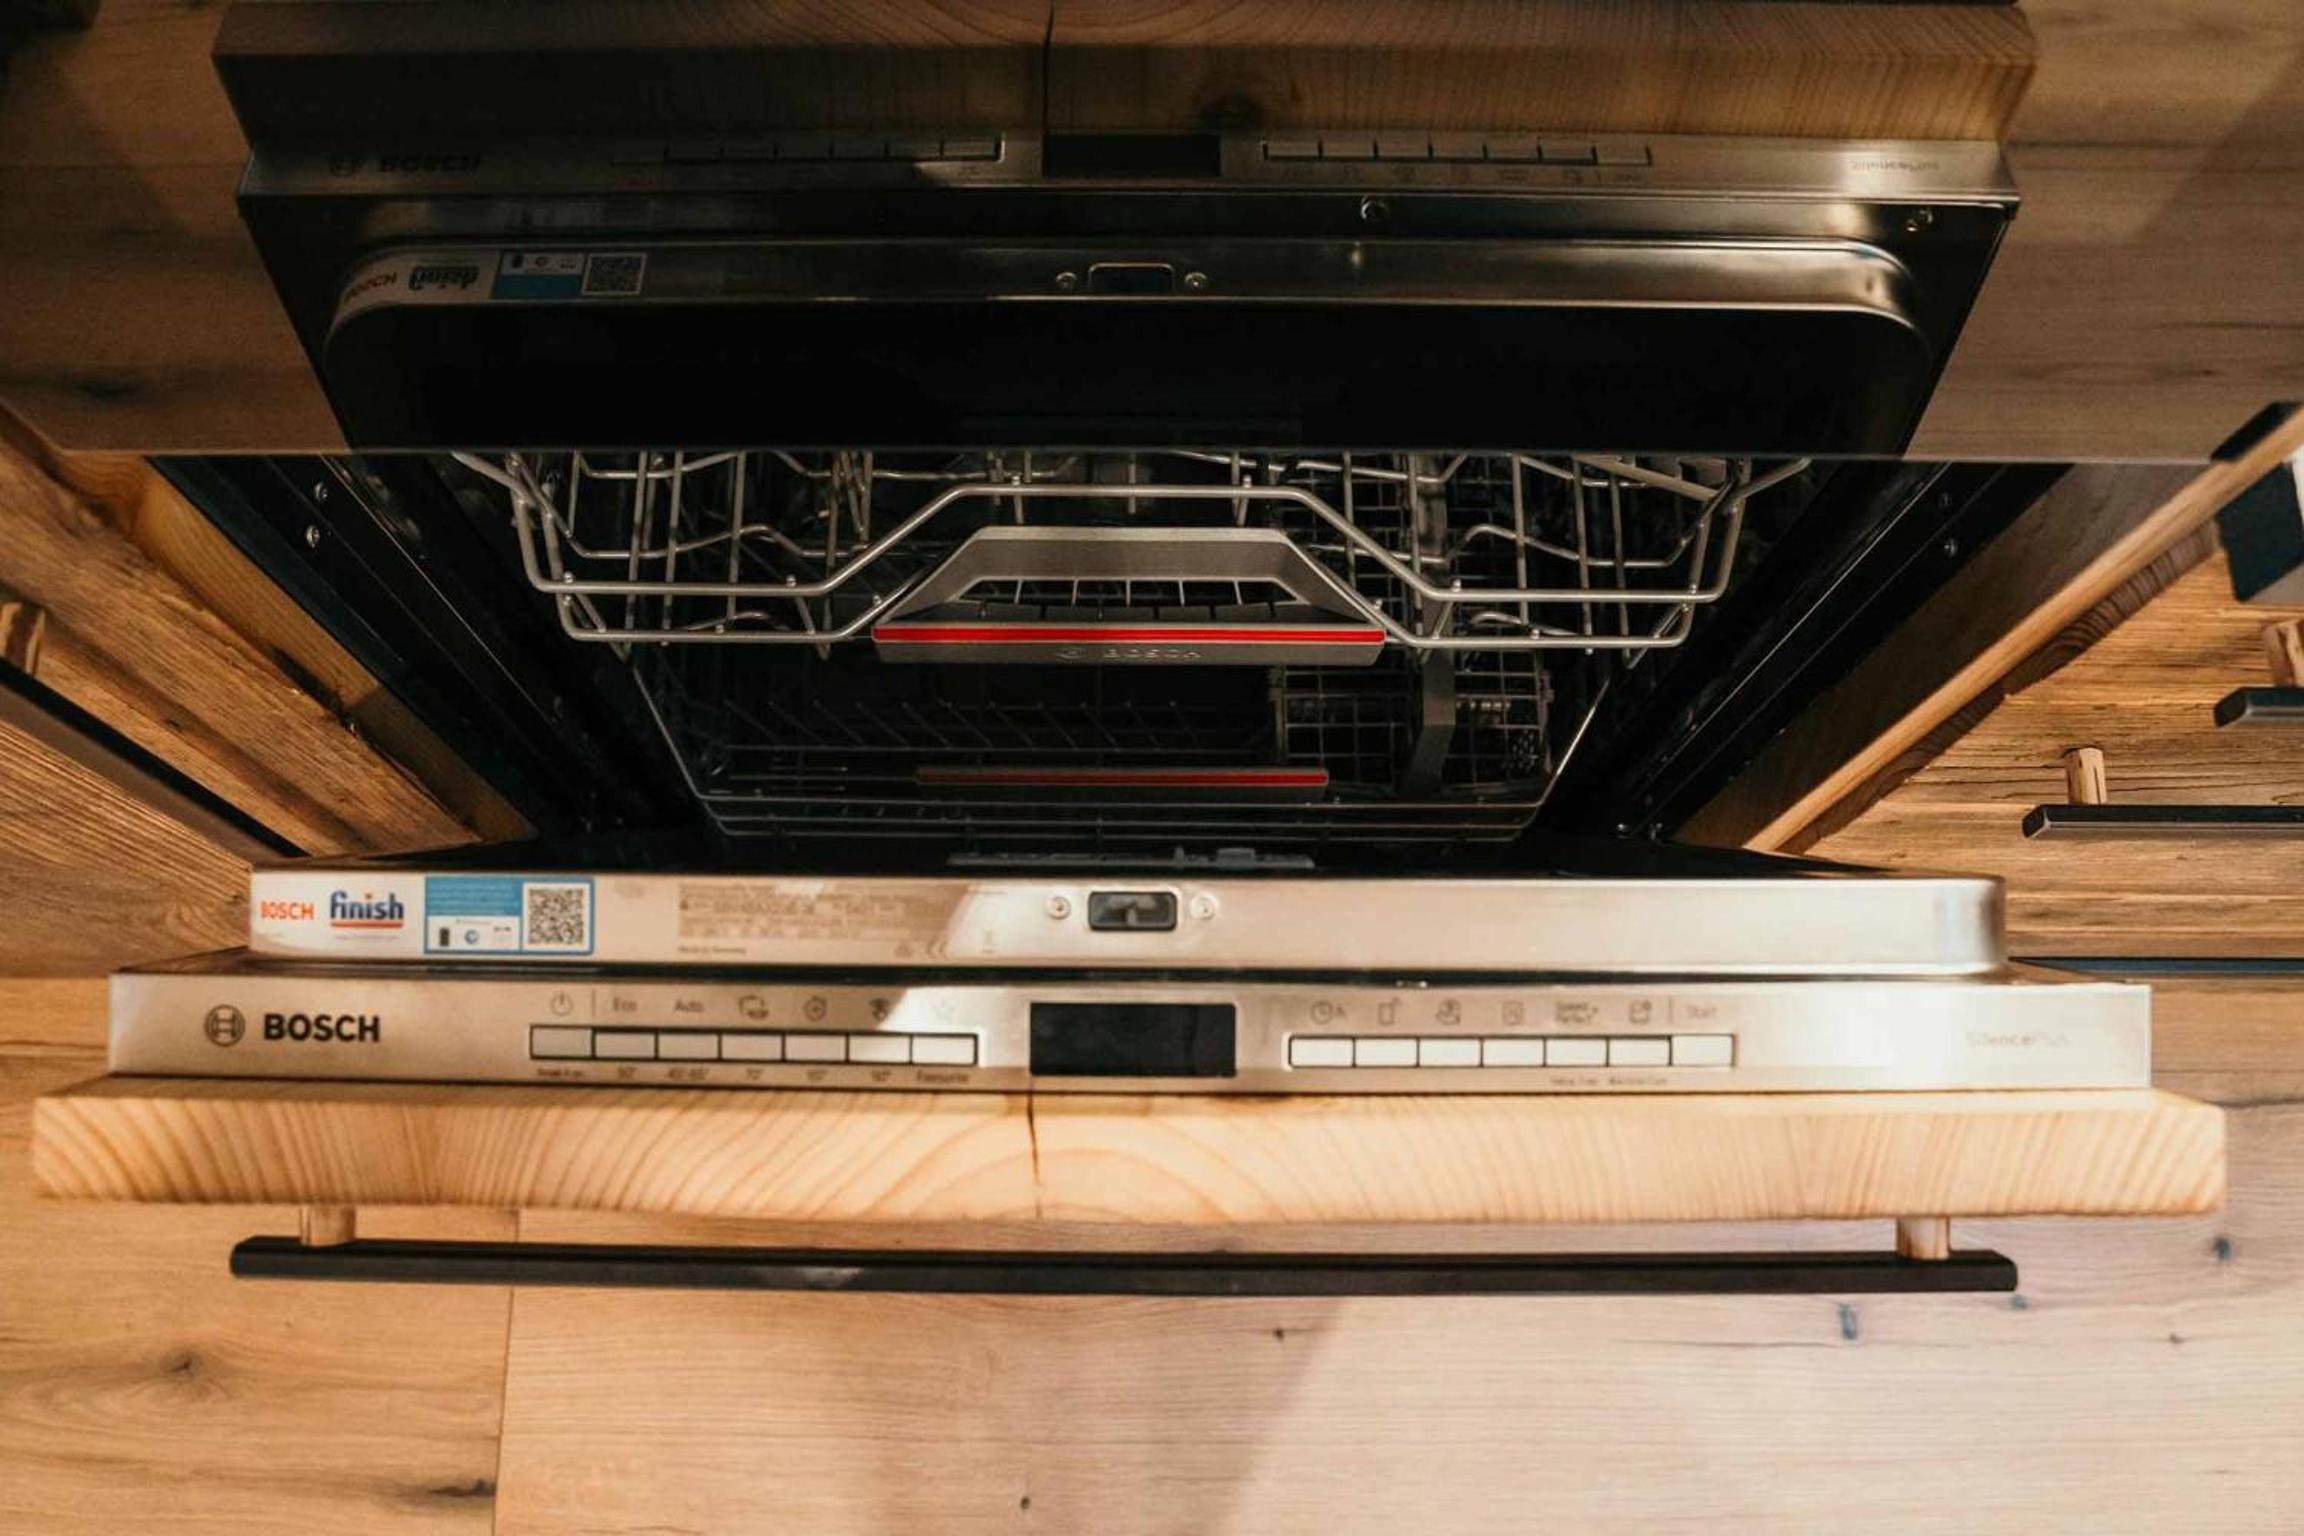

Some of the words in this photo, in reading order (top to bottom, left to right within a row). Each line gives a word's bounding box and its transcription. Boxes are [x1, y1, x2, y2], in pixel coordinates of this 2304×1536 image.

[260, 901, 315, 920] BOSCH
[330, 890, 404, 920] finish
[263, 1013, 381, 1042] BOSCH
